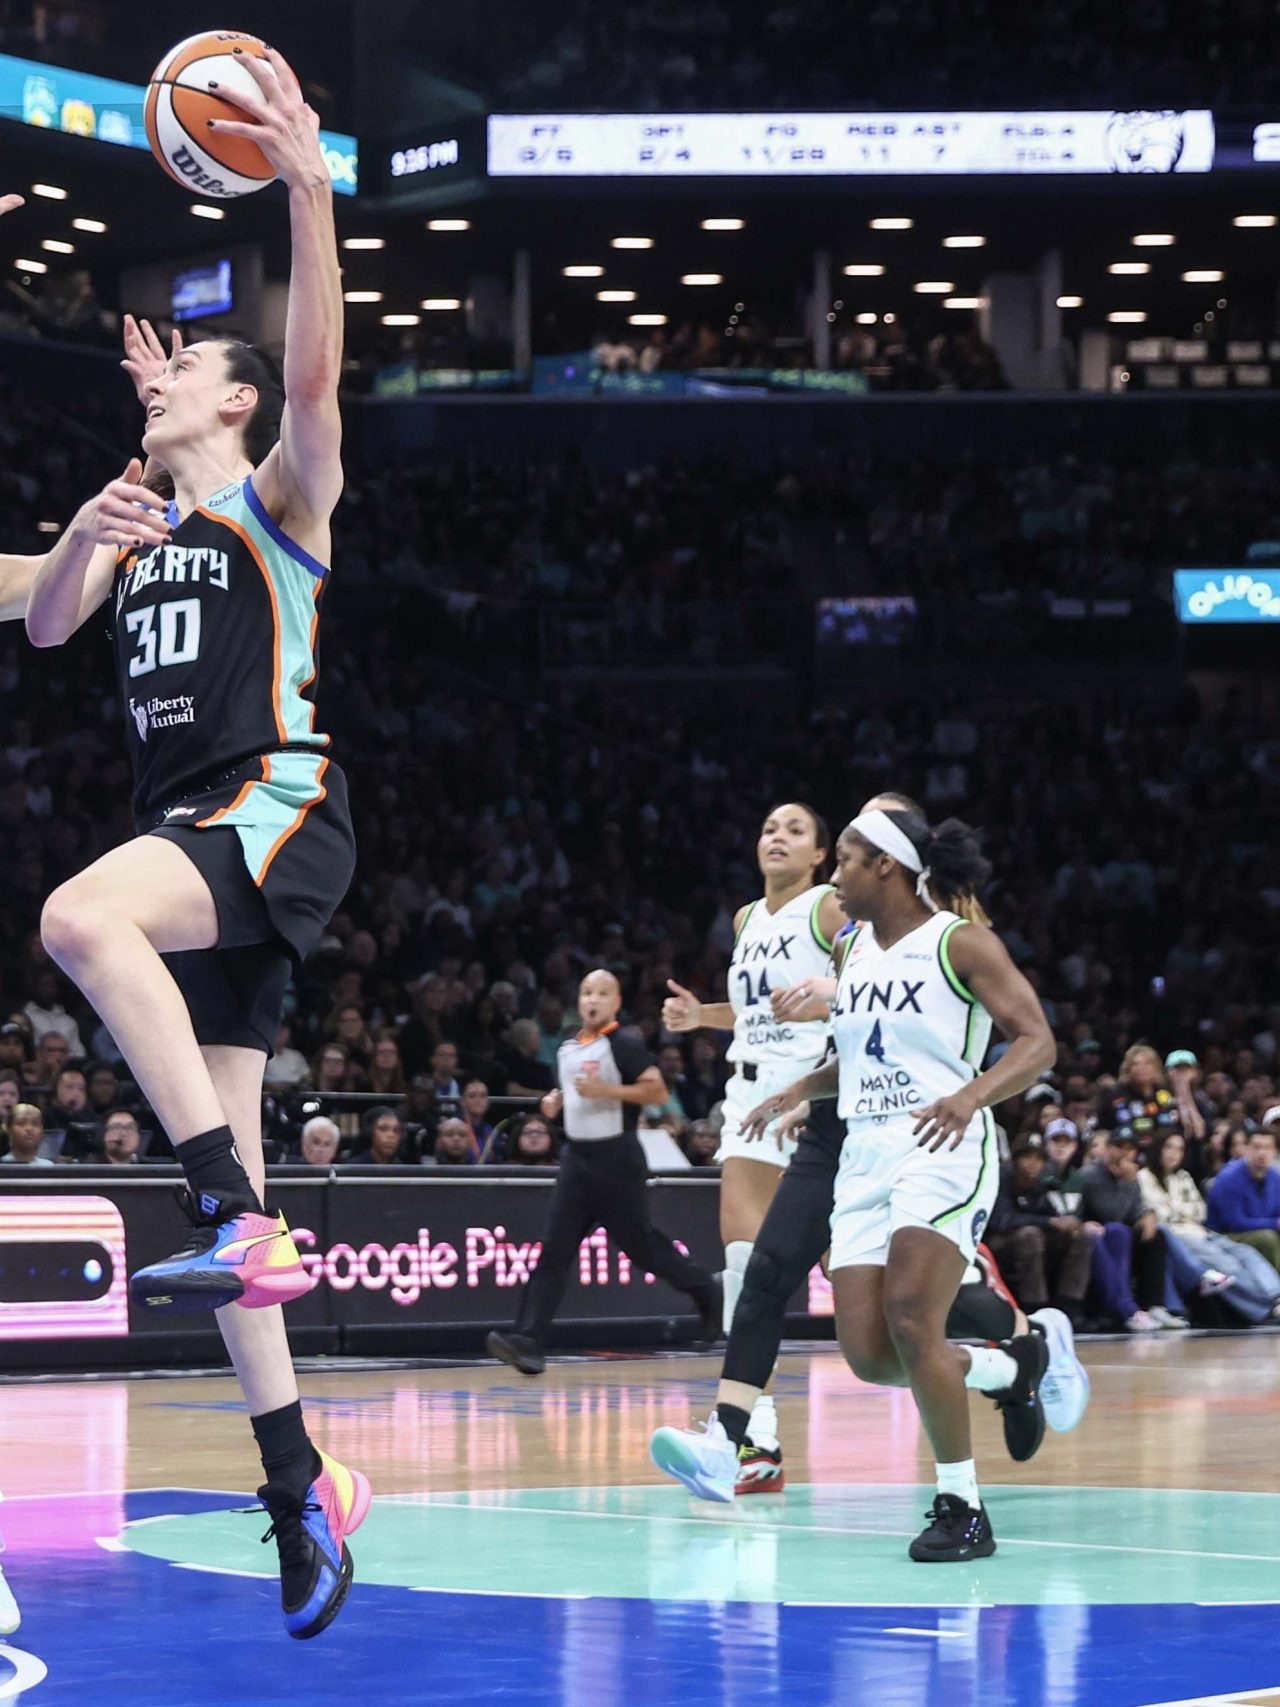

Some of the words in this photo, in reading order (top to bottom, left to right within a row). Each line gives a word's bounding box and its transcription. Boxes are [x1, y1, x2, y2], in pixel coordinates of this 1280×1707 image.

[125, 598, 201, 679] 30
[147, 694, 195, 715] Liberty
[865, 1017, 885, 1064] 4
[860, 1070, 911, 1093] MAYO
[855, 1089, 921, 1114] CLINIC
